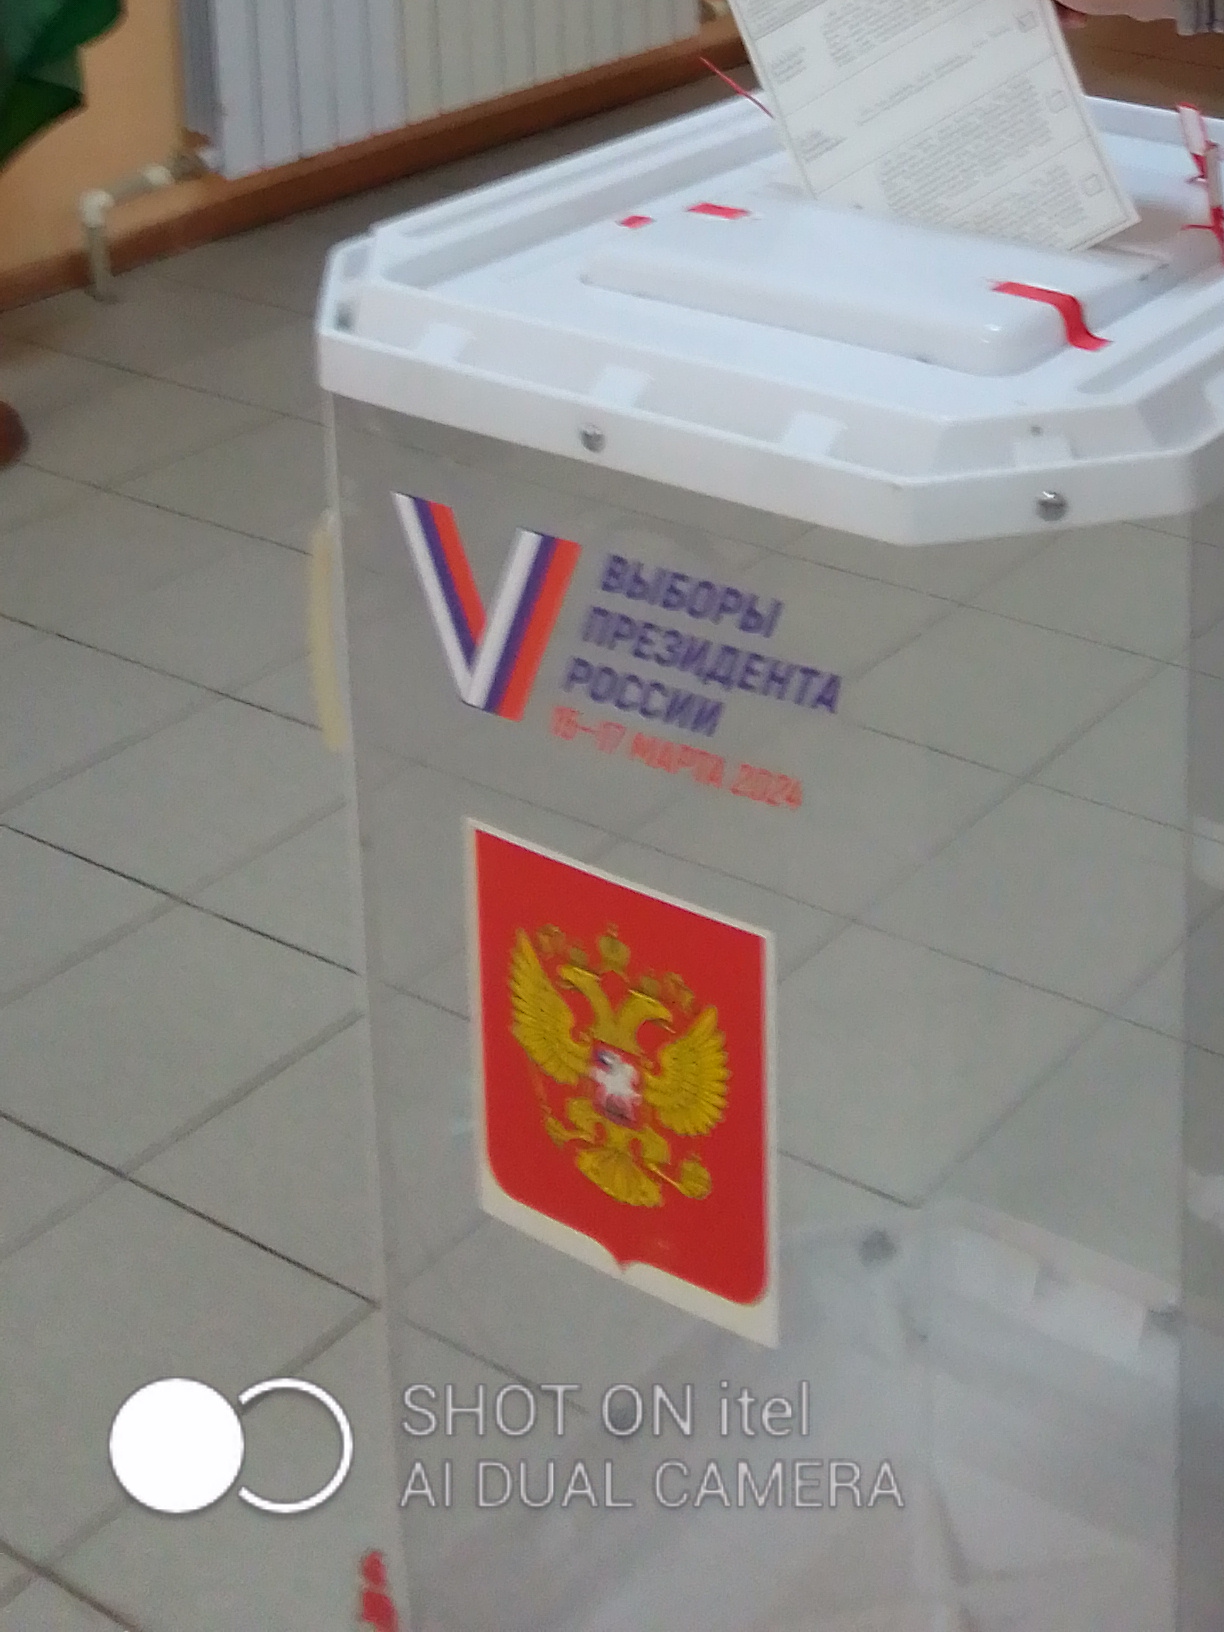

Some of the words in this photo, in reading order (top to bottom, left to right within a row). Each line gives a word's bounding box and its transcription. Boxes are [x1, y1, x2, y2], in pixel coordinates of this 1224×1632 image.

[601, 554, 784, 638] ВЫБОРЫ
[563, 657, 725, 737] РОССИИ
[580, 605, 842, 714] ПРЕЗИДЕНТА
[631, 732, 725, 788] МАРТА
[731, 763, 802, 810] 2024
